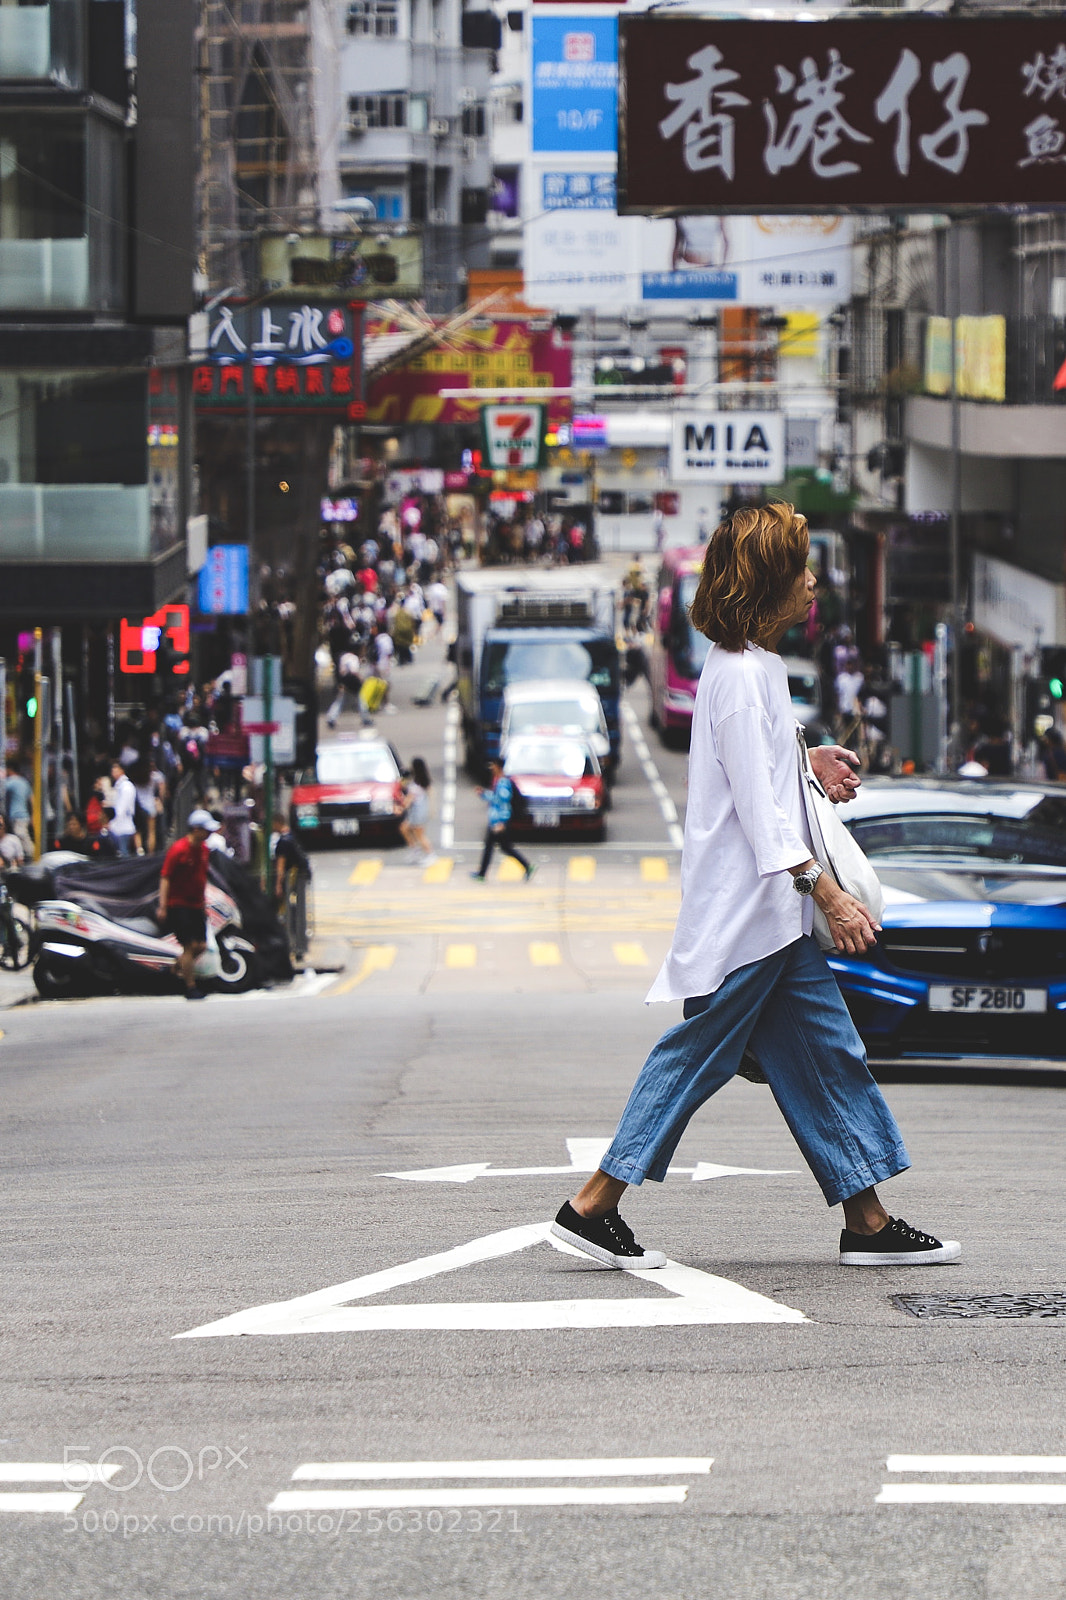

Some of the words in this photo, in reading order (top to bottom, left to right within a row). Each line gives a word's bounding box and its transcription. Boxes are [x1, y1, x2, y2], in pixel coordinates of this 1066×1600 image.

[659, 45, 988, 181] 香港仔
[495, 413, 533, 466] 7
[685, 424, 769, 452] MIA
[952, 988, 976, 1008] SF
[980, 989, 1026, 1010] 2810
